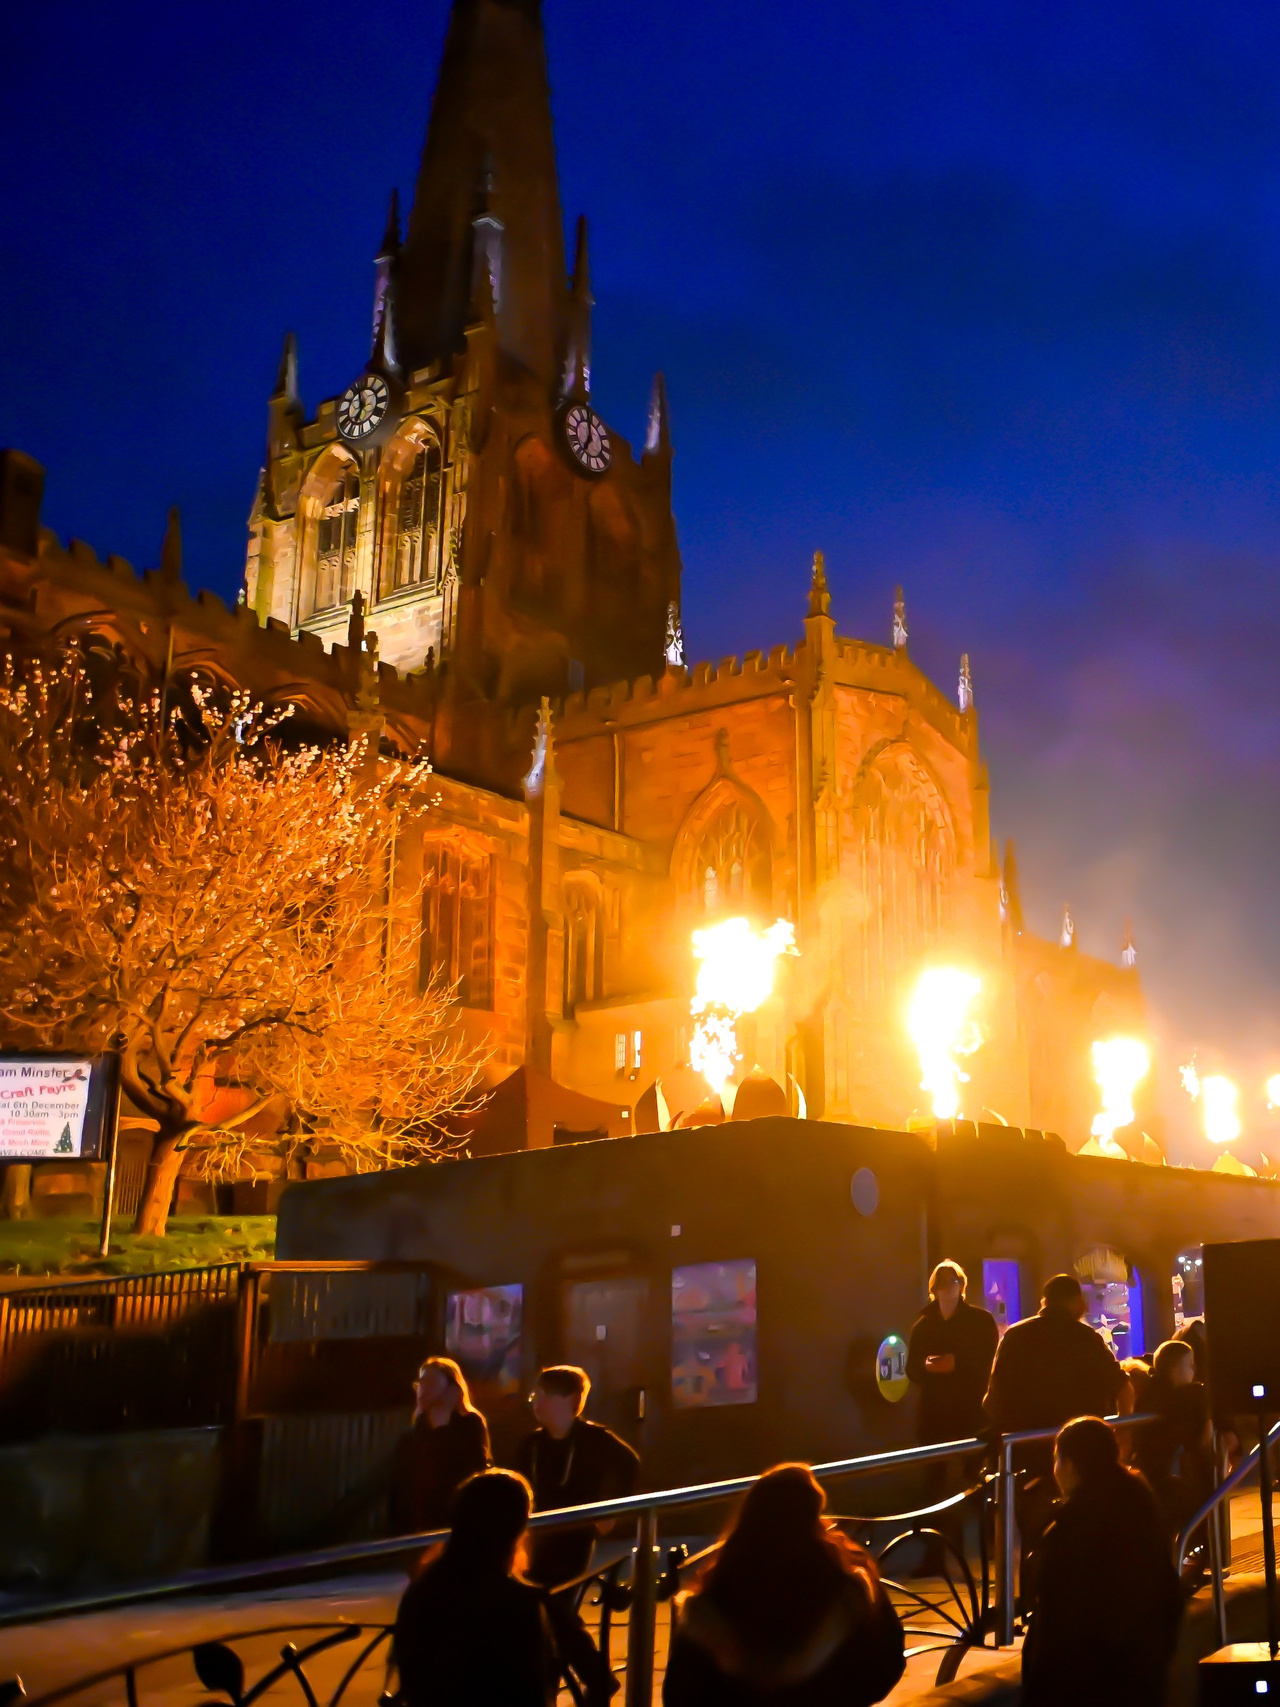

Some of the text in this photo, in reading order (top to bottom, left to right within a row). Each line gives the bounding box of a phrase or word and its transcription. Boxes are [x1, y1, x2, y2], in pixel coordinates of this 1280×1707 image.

[21, 1067, 67, 1077] Minster
[0, 1084, 76, 1099] Craft Fayre
[0, 1102, 10, 1110] at
[31, 1101, 80, 1110] December
